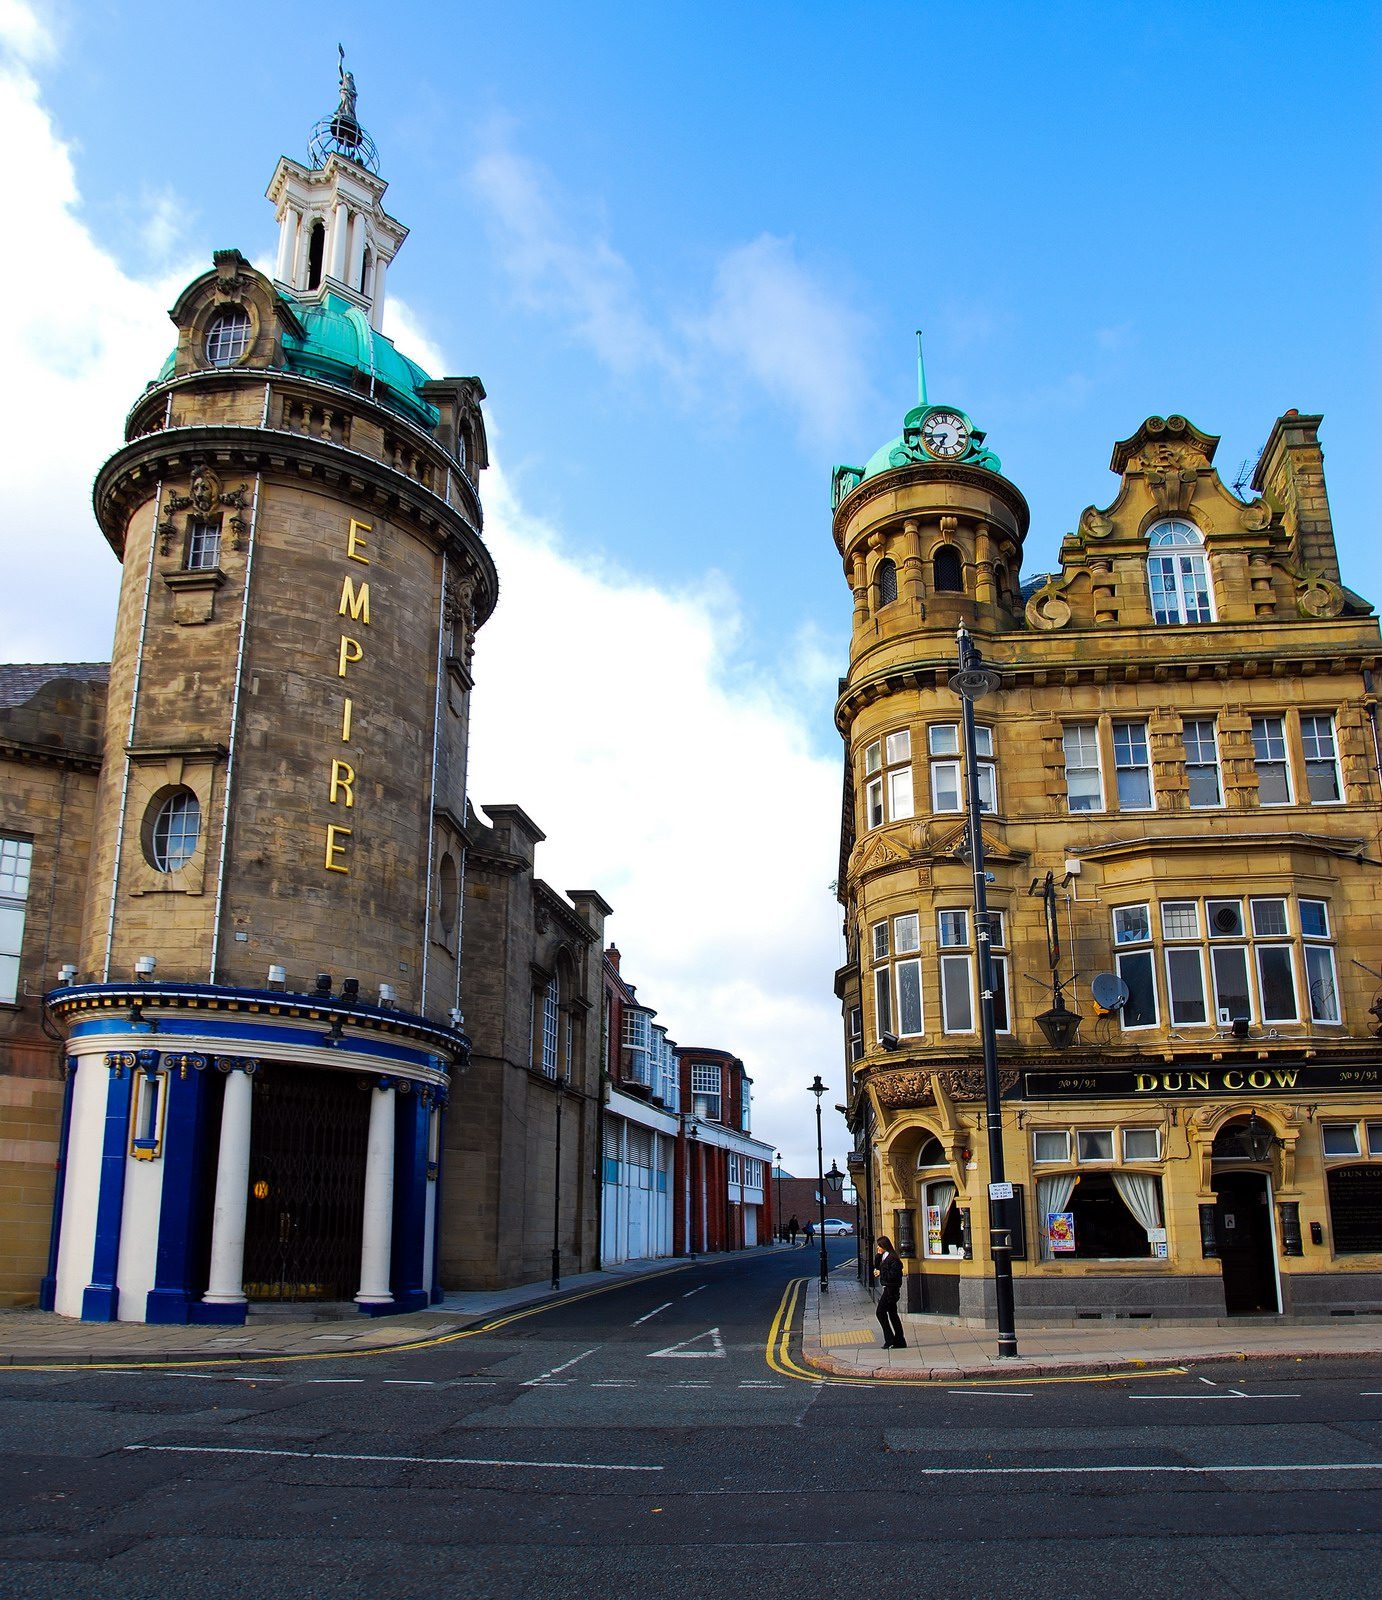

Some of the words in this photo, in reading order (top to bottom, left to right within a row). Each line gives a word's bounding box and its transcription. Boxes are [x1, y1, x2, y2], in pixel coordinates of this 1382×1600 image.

[324, 517, 374, 874] EMPIRE
[1133, 1071, 1211, 1092] DUN
[1222, 1069, 1300, 1090] COW
[1354, 1070, 1378, 1082] 9/9A
[1073, 1078, 1096, 1090] 9/9A
[1339, 1170, 1362, 1178] DUN
[1365, 1169, 1382, 1177] CO
